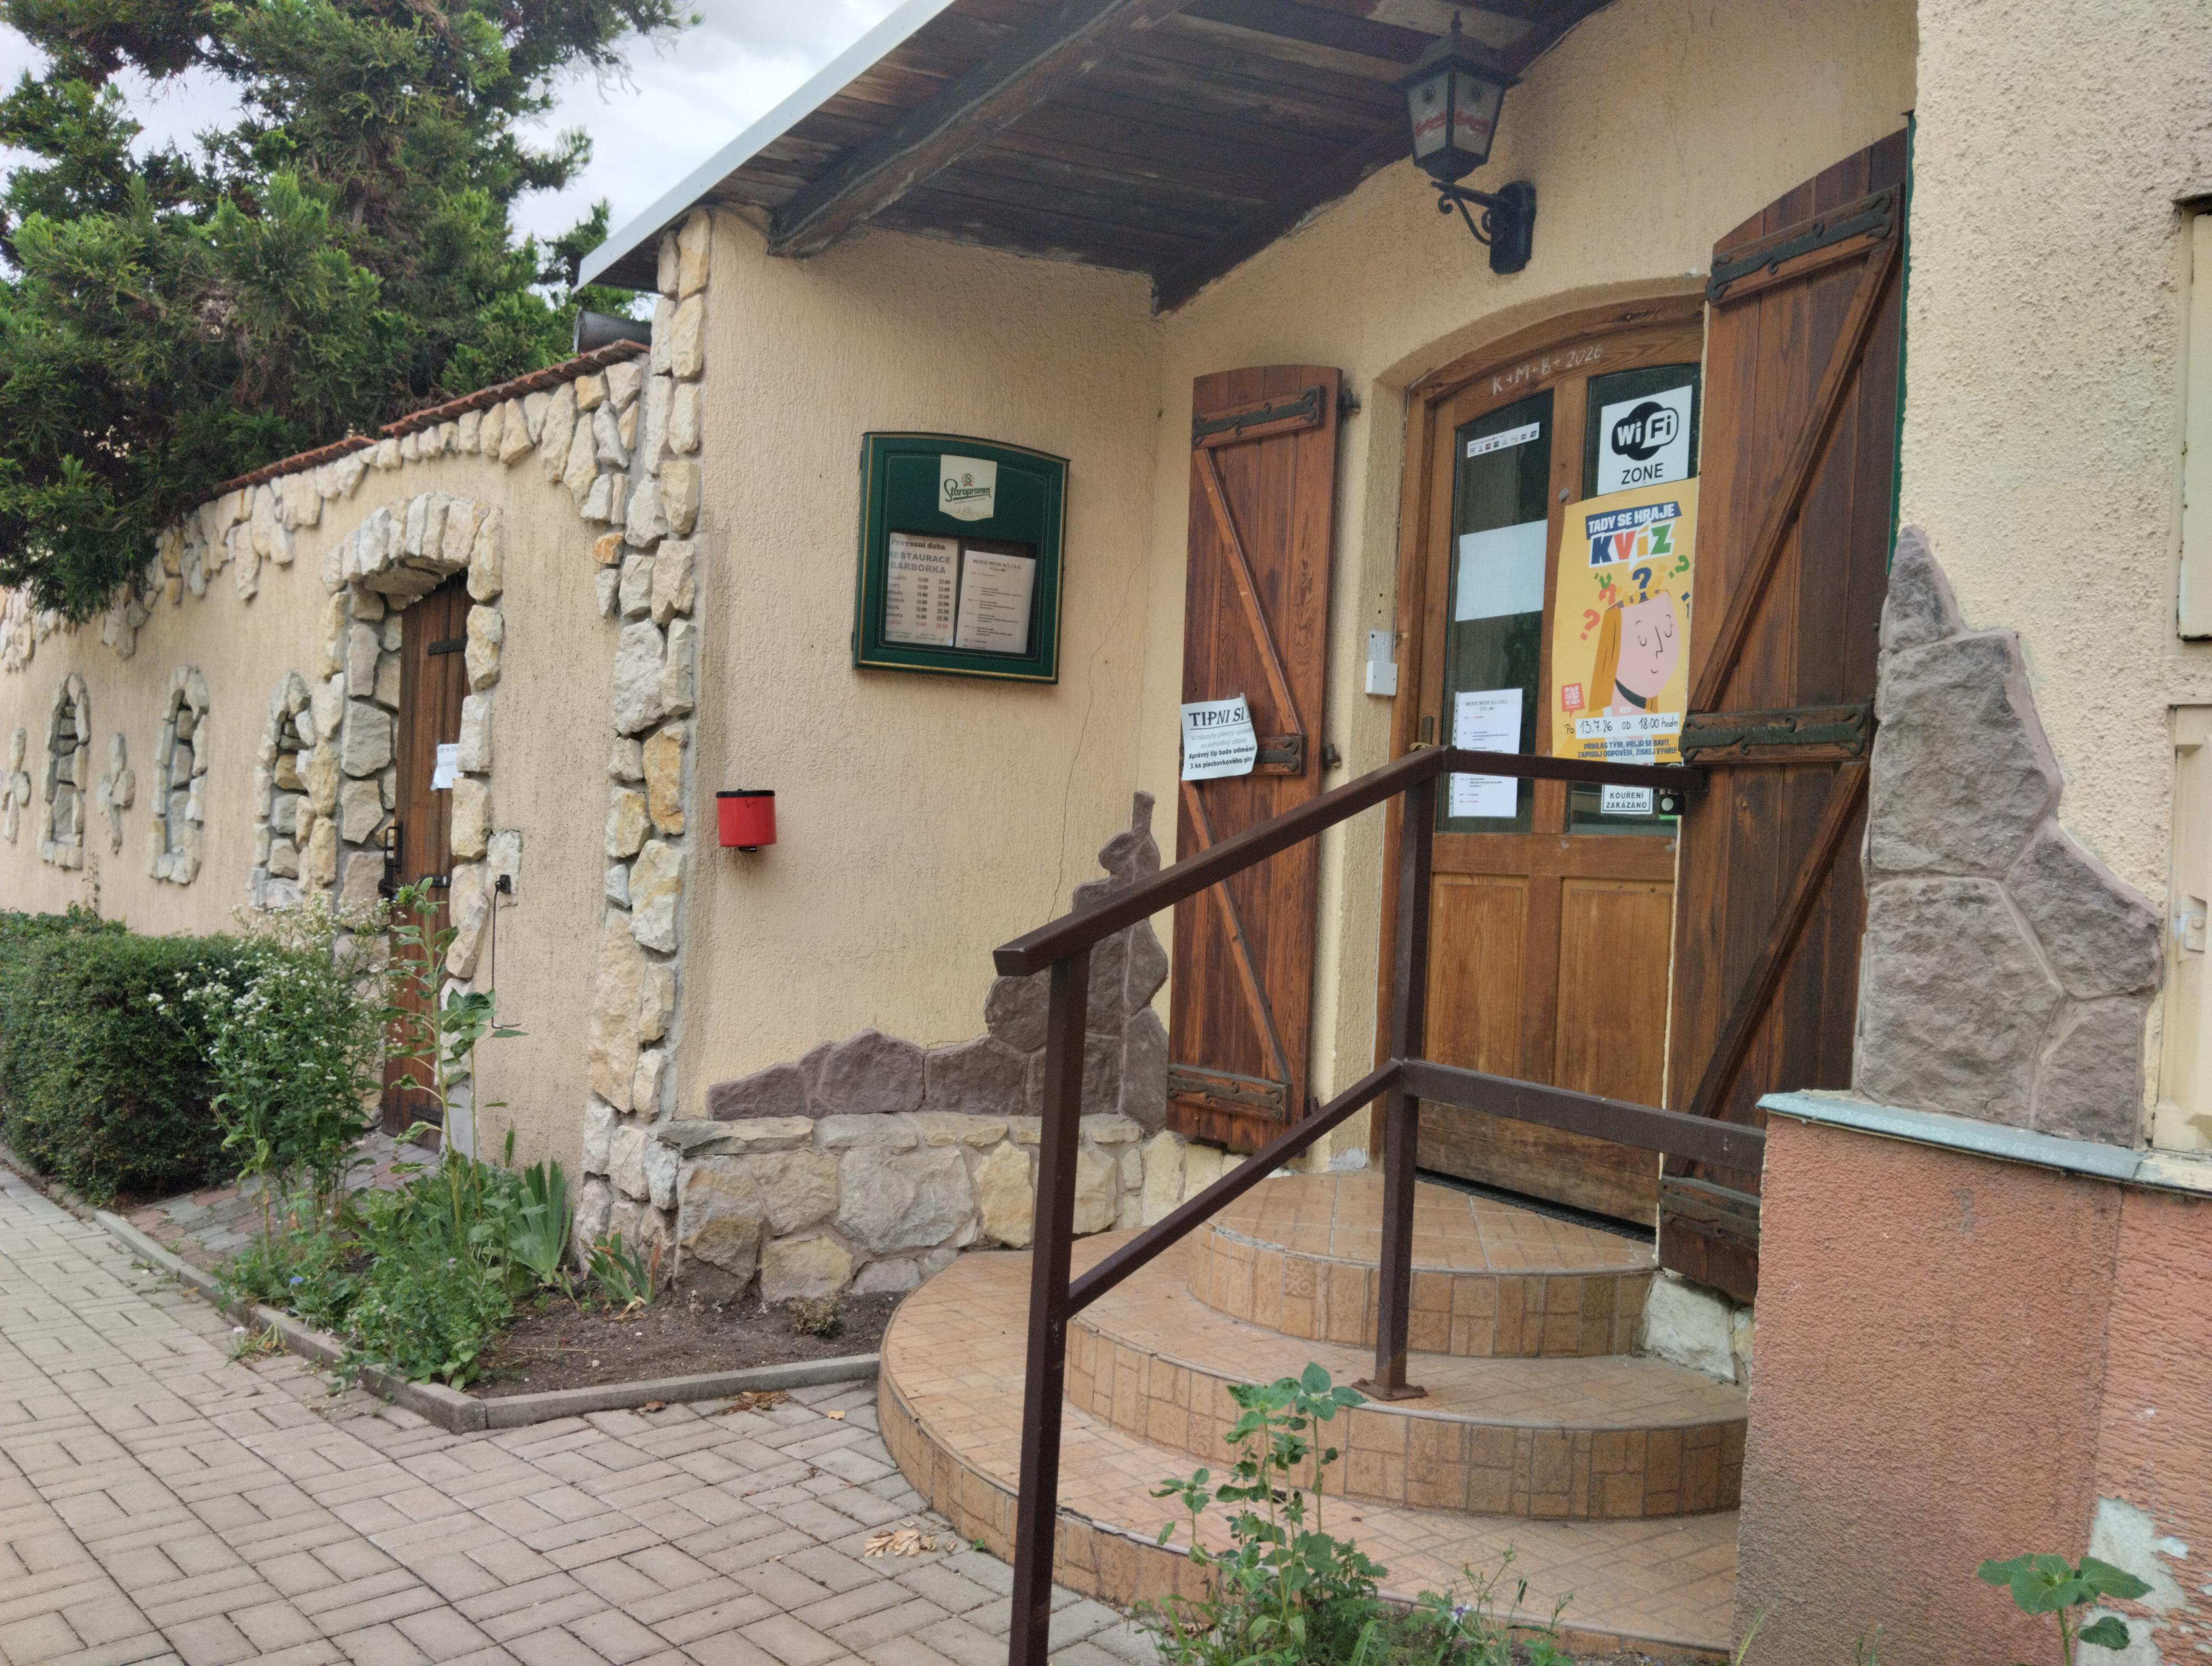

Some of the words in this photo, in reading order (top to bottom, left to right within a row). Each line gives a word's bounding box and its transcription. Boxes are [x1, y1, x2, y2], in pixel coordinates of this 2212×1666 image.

[1621, 463, 1664, 485] ZONE
[944, 479, 992, 502] Staropramen
[1588, 515, 1616, 534] TADY
[1617, 512, 1632, 527] SE
[1634, 503, 1675, 524] HRAJE
[927, 542, 946, 550] doba
[889, 550, 951, 564] RESTAURACE
[889, 561, 946, 574] BARBORKA
[1188, 710, 1230, 726] TIPNI
[1233, 706, 1244, 722] SI
[1580, 719, 1612, 734] 13.7.26
[1622, 721, 1631, 730] OD
[1639, 717, 1660, 729] 18:00
[1188, 751, 1209, 760] Správný
[1610, 790, 1645, 799] KOUŘENÍ
[1606, 800, 1647, 809] ZAKÁZÁNO
